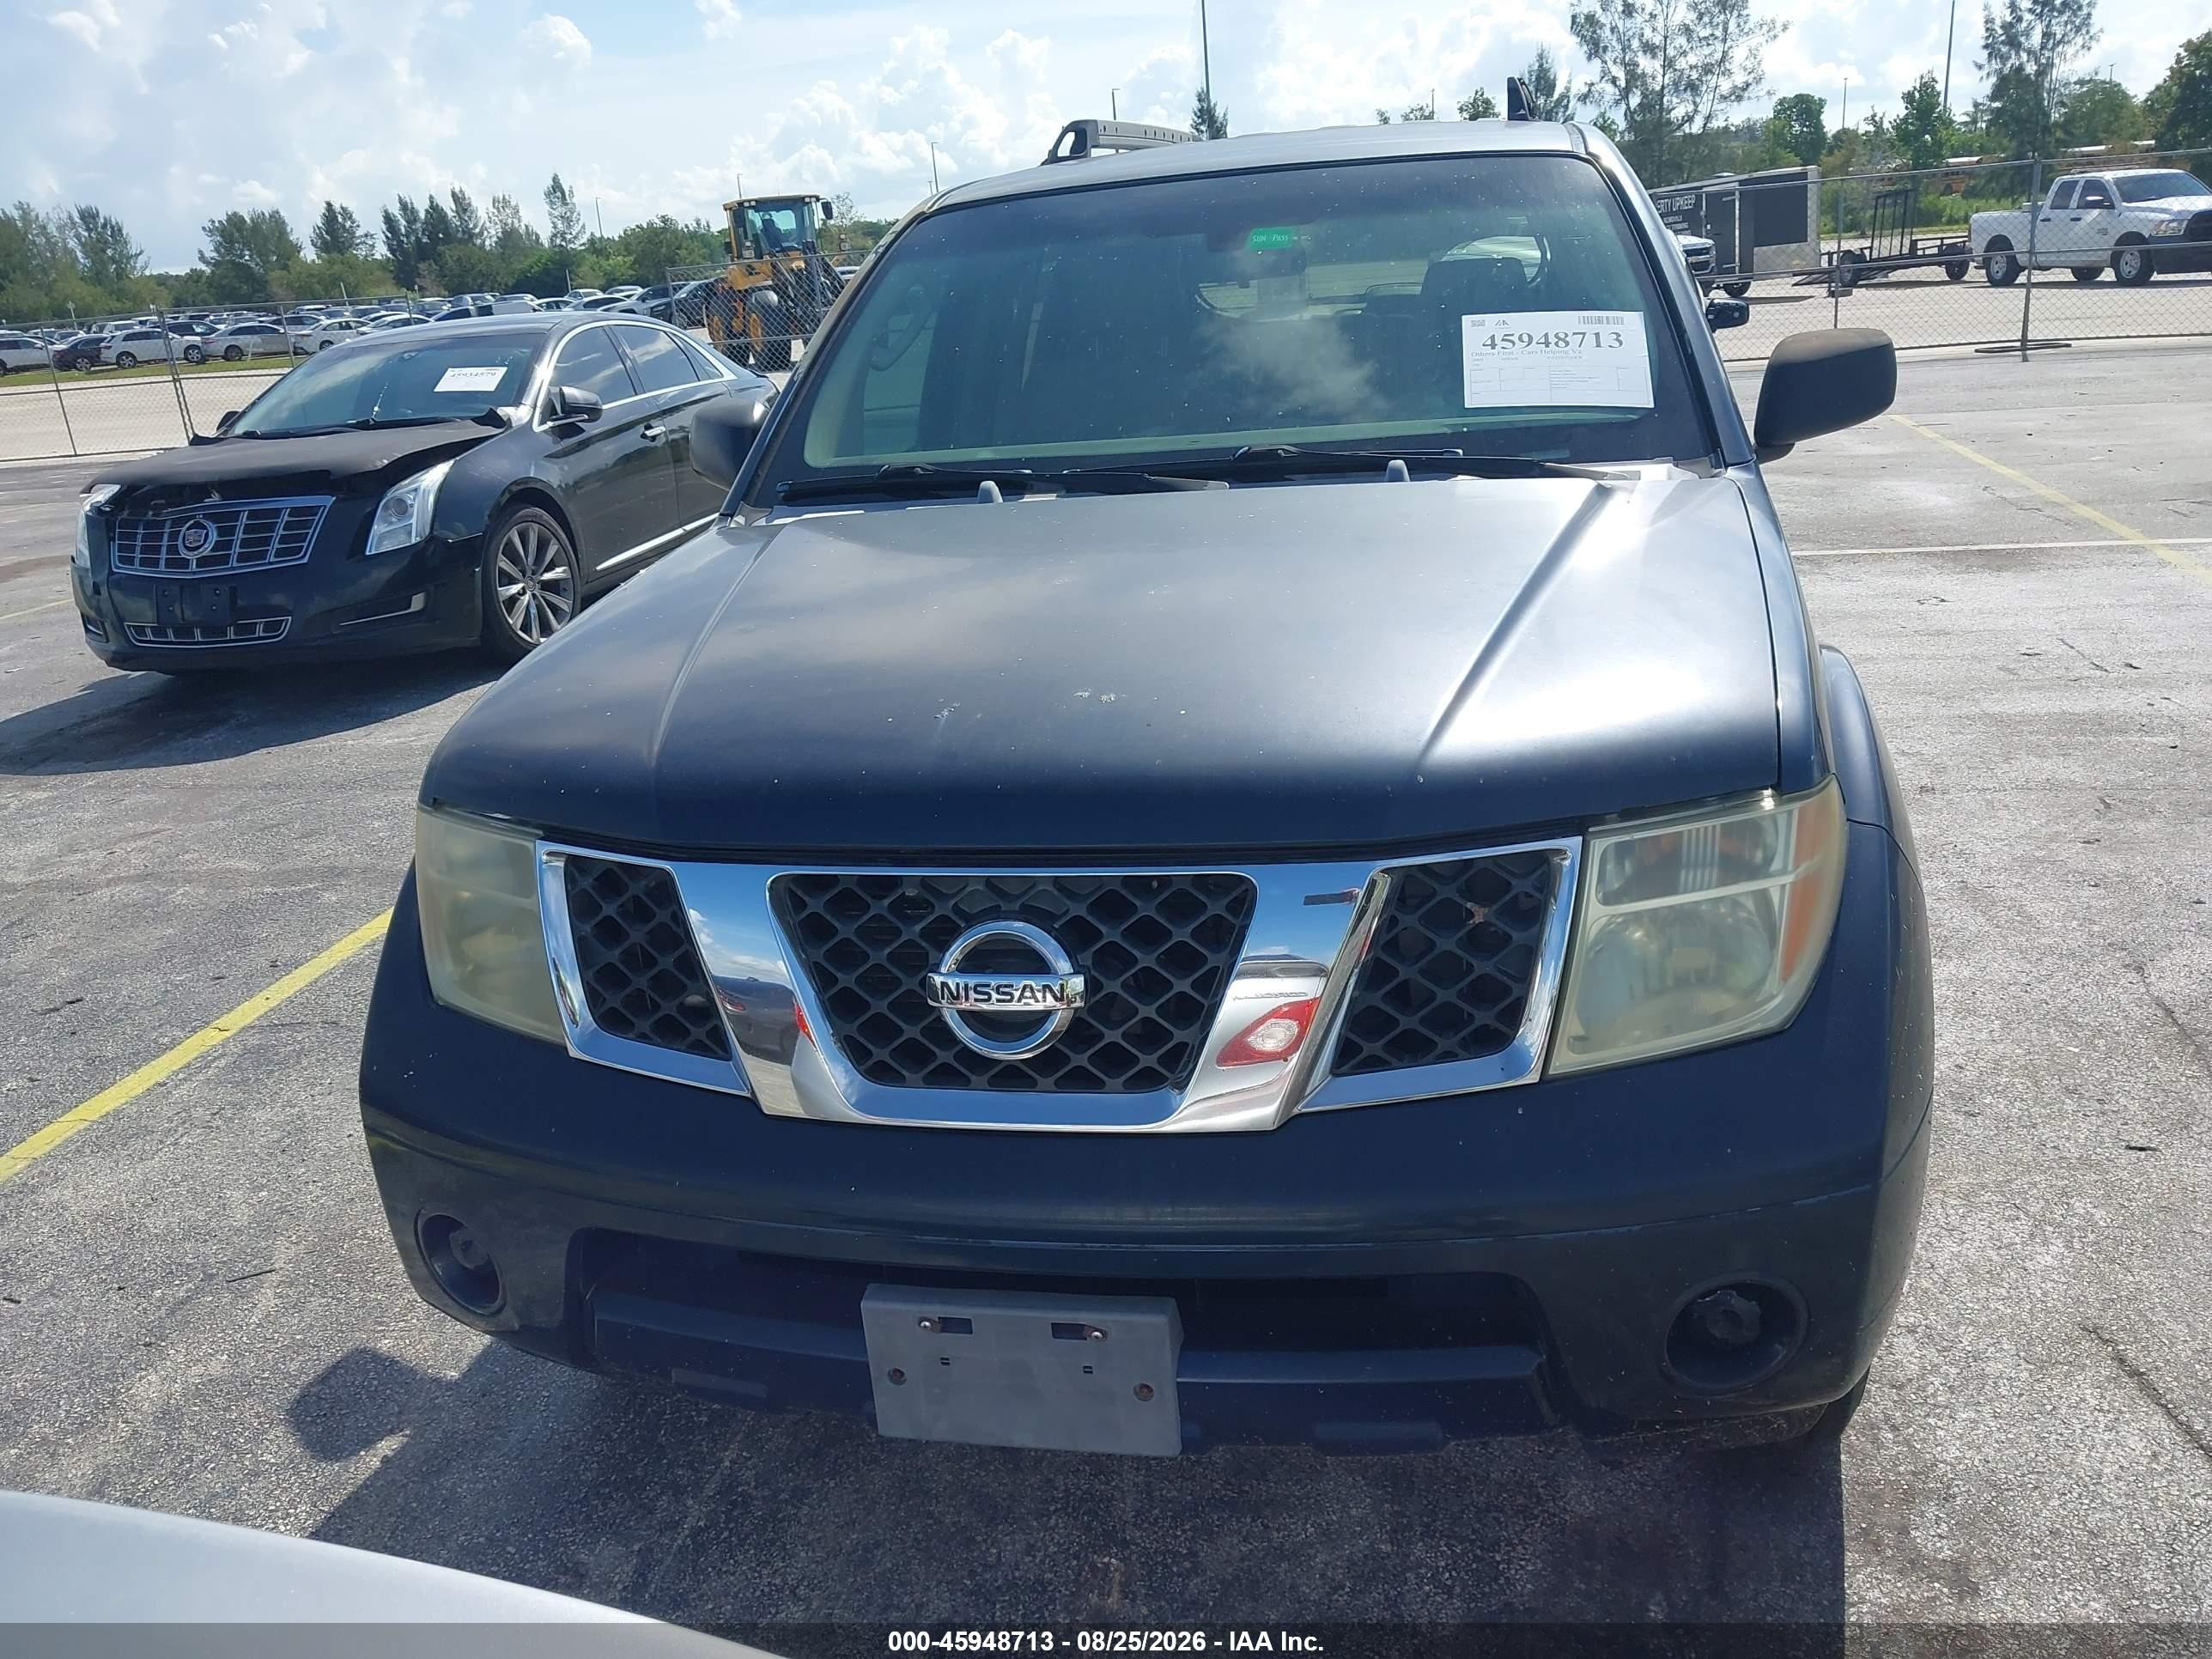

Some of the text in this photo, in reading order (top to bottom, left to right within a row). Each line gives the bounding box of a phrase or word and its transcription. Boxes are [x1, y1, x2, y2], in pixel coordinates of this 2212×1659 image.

[1656, 194, 1696, 214] ERTY UPKEEP
[1482, 331, 1624, 350] 45948713
[939, 980, 1066, 1005] NISSAN
